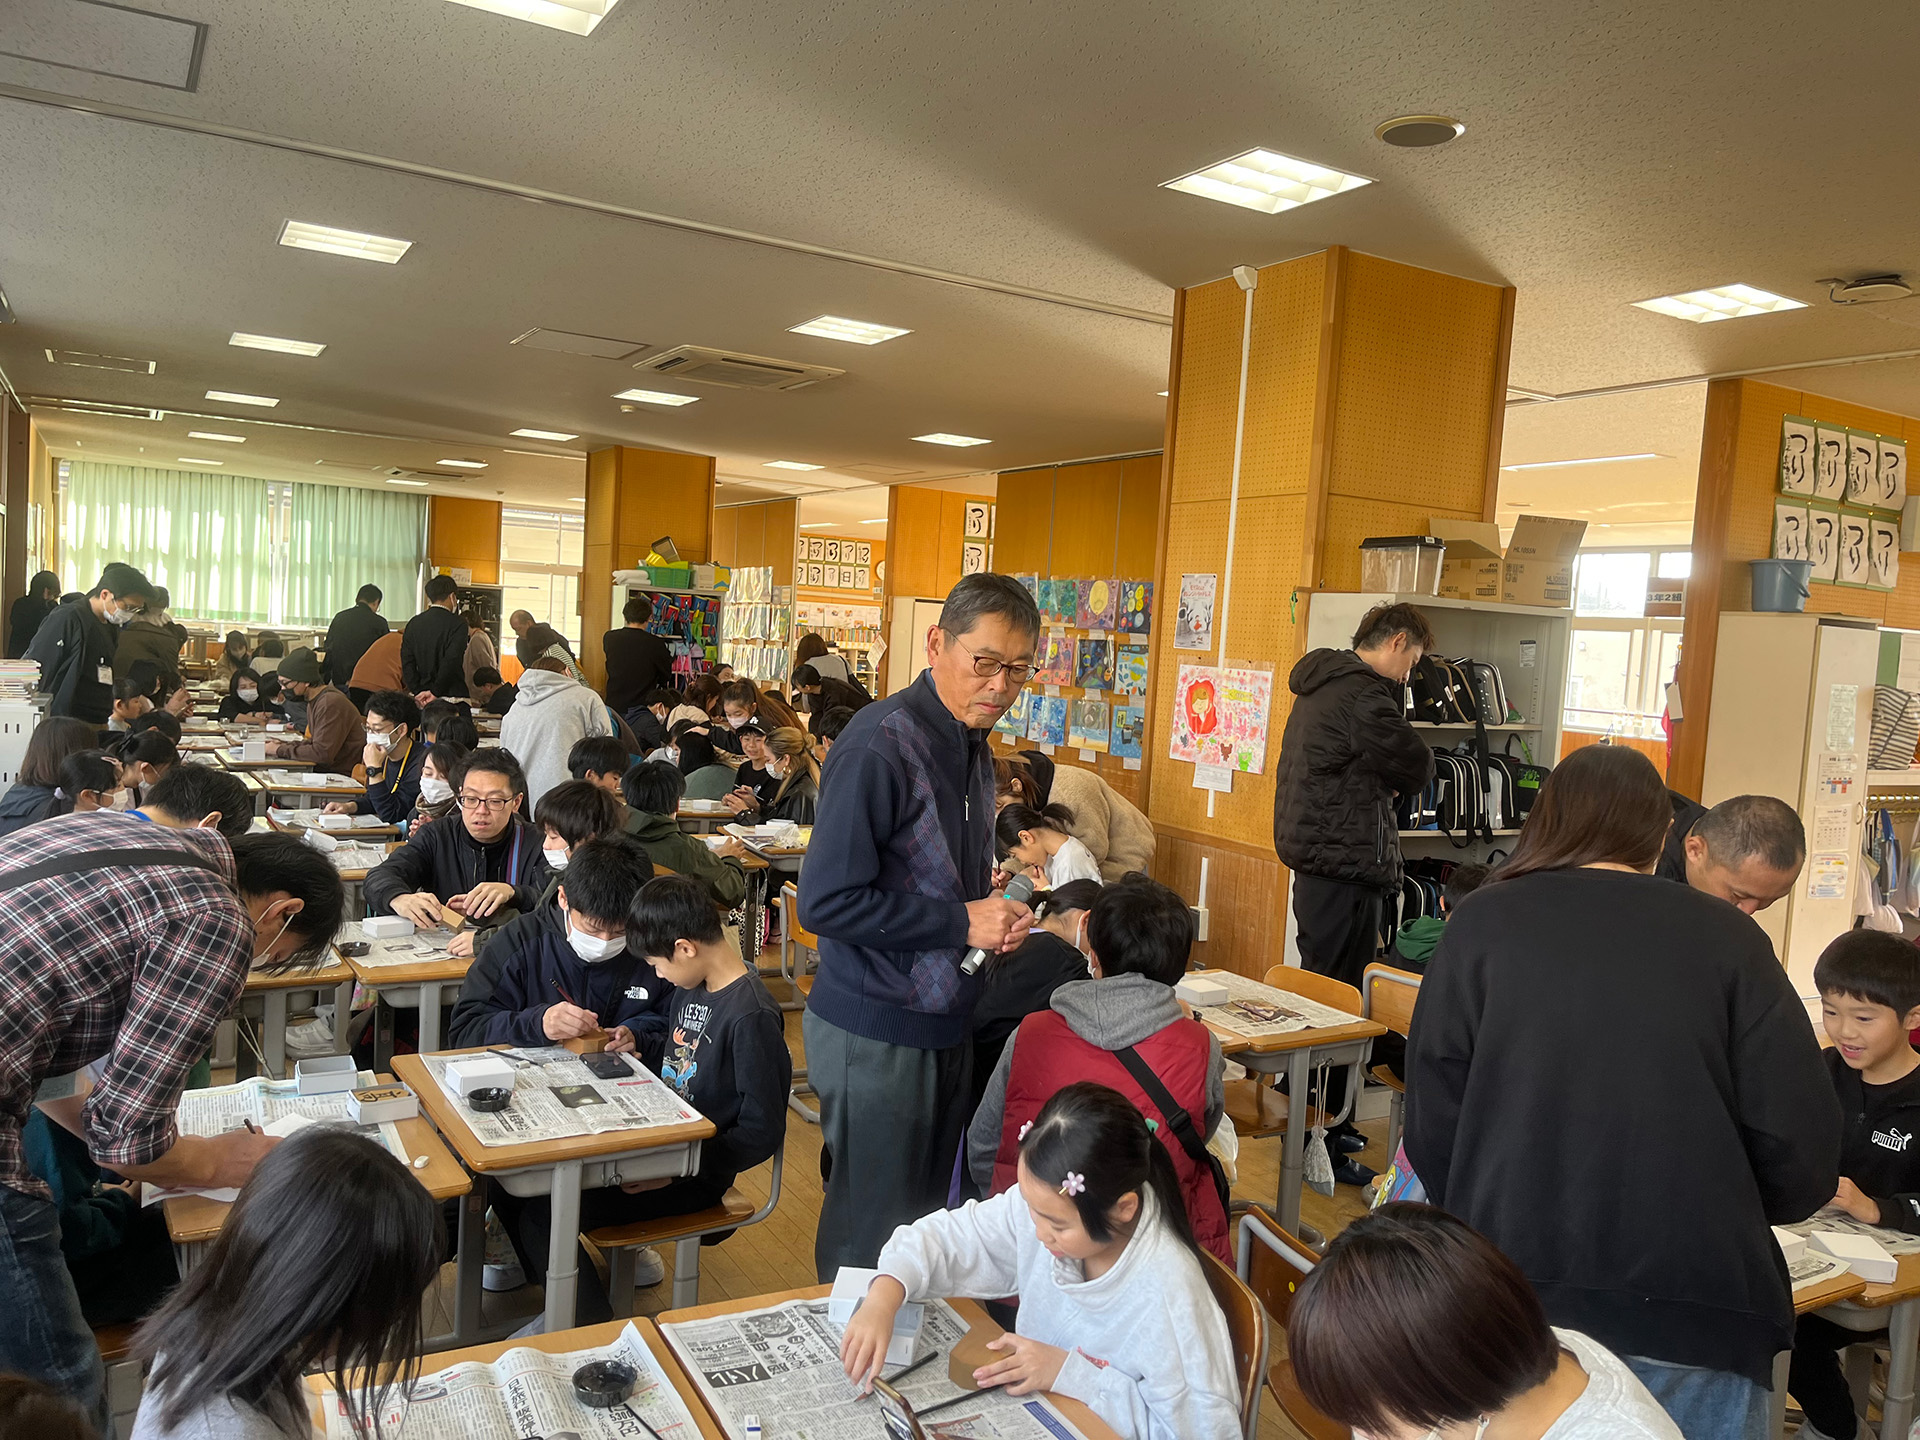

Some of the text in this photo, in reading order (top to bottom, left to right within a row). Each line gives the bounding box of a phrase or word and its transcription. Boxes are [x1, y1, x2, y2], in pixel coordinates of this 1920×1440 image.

[1790, 433, 1808, 484] つり
[1825, 440, 1840, 488] つり
[1856, 446, 1872, 494] つり
[1884, 452, 1900, 500] つり
[970, 508, 984, 534] つり
[1784, 515, 1800, 561] つり
[1816, 518, 1833, 566] つり
[828, 542, 838, 560] つり
[968, 547, 983, 572] つり
[1848, 525, 1864, 575] つり
[1877, 530, 1893, 577] つり
[1647, 592, 1682, 602] 3年2組
[1871, 1130, 1903, 1152] PUMA
[508, 1378, 540, 1439] 日本旅行 販売停止
